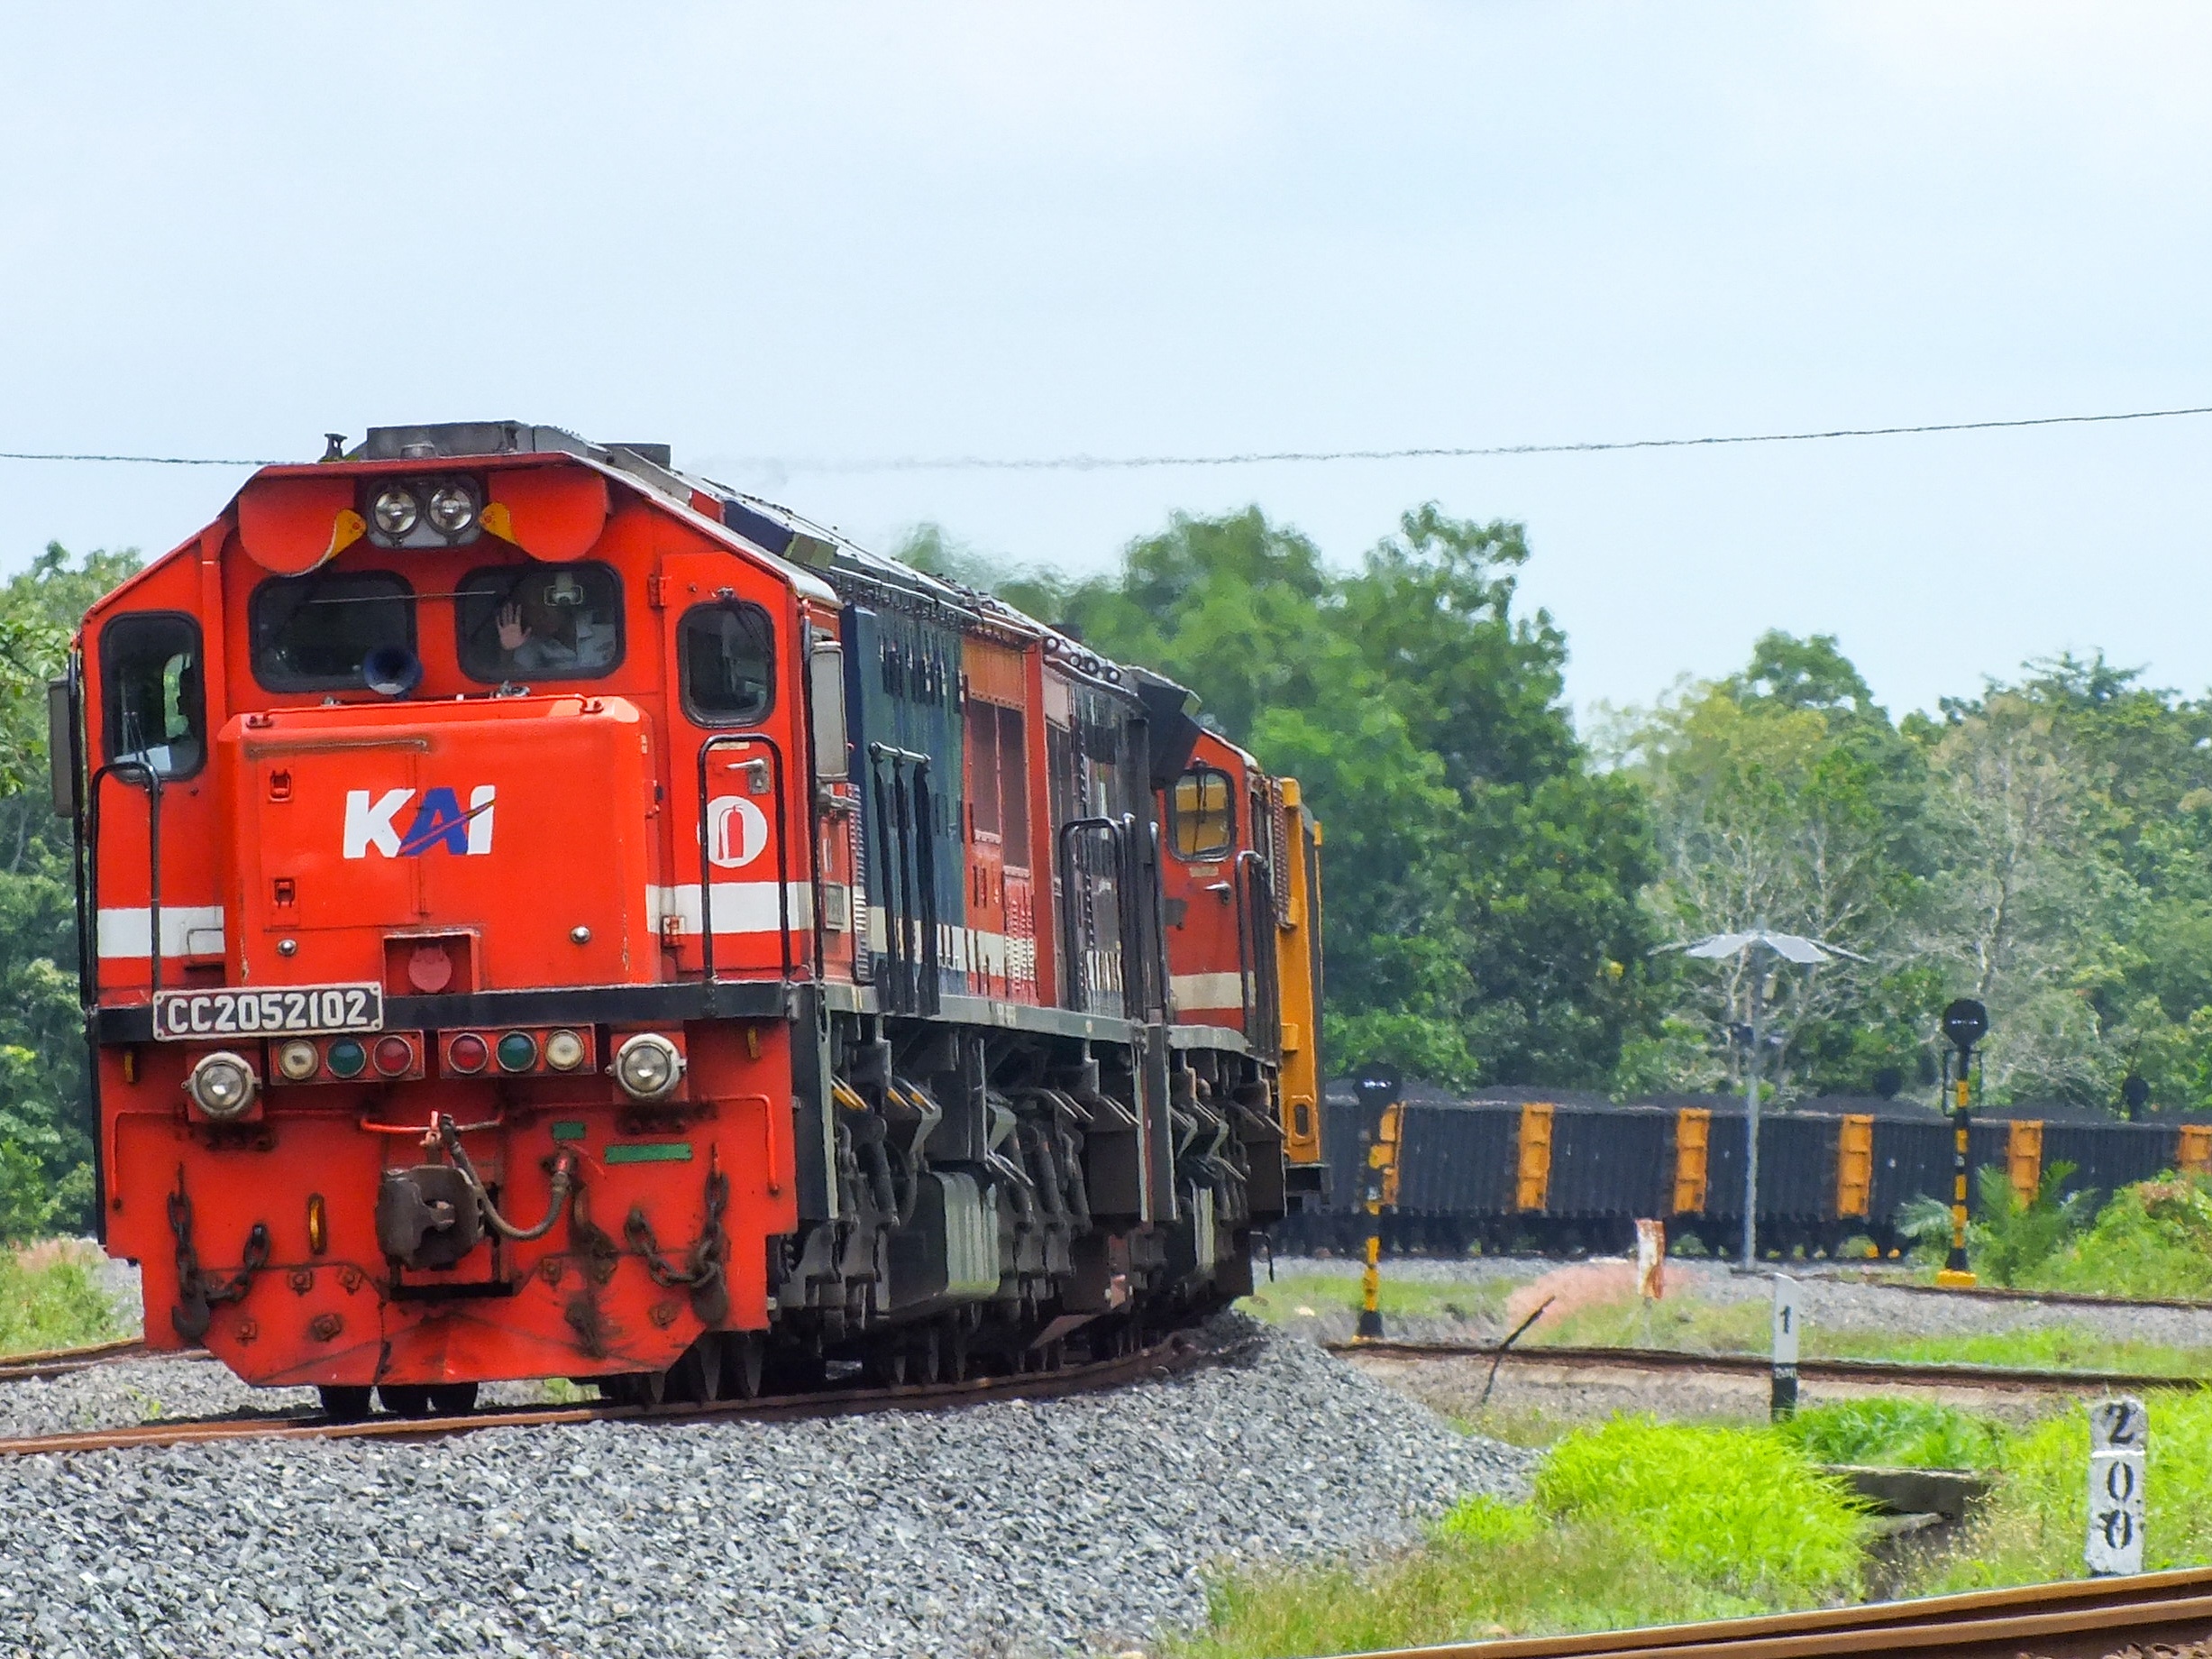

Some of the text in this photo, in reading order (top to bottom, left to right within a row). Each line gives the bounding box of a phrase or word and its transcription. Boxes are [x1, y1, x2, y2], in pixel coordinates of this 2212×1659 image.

[343, 784, 496, 858] KAI
[168, 991, 368, 1033] CC2052102
[1780, 1306, 1792, 1334] 1
